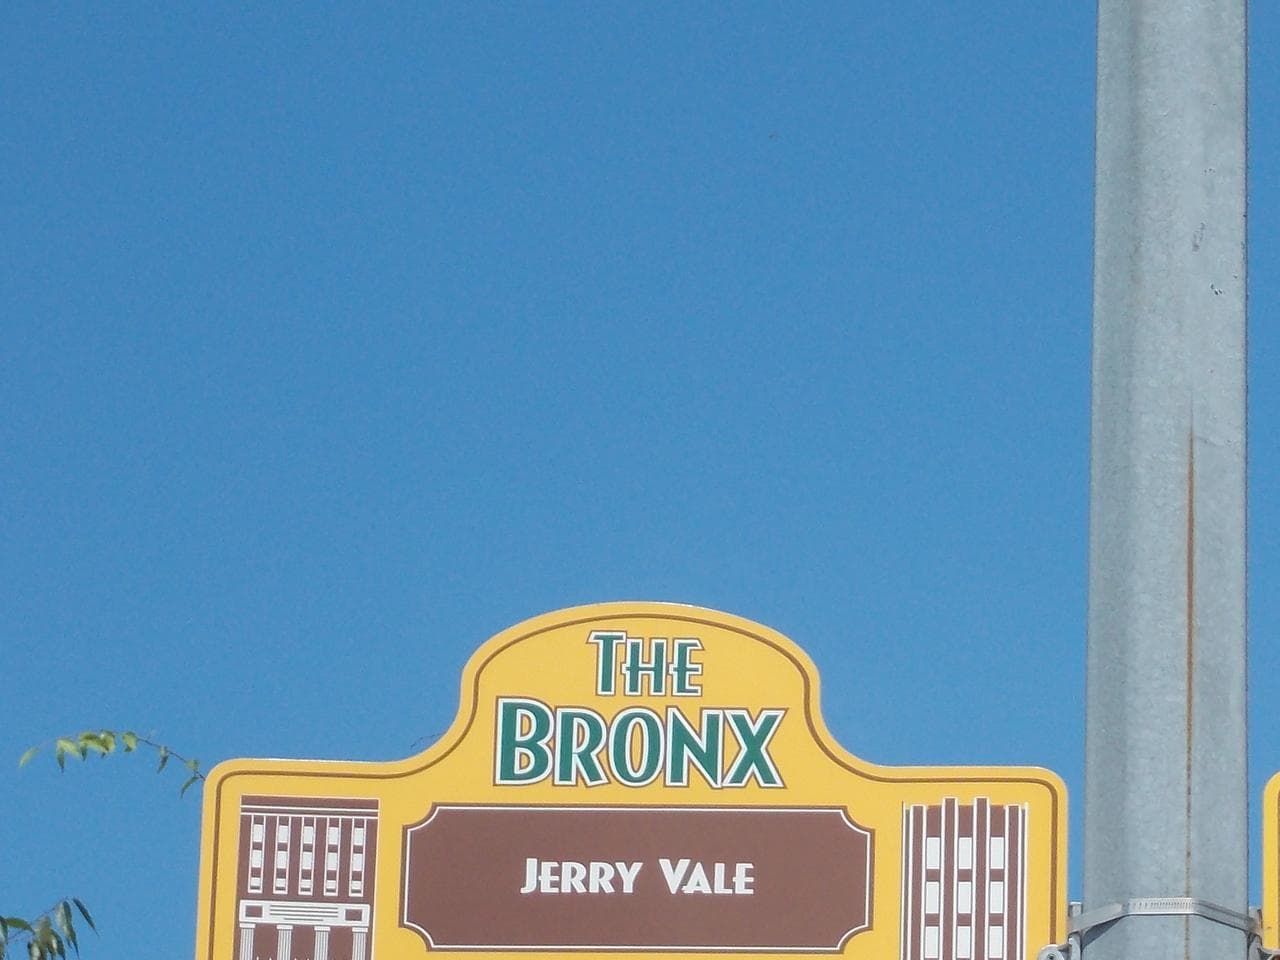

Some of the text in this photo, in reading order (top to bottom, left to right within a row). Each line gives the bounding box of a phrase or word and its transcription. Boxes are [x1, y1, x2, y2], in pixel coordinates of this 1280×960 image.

[588, 629, 704, 697] THE
[494, 696, 789, 789] BRONX
[520, 857, 756, 895] JERRY VALE
